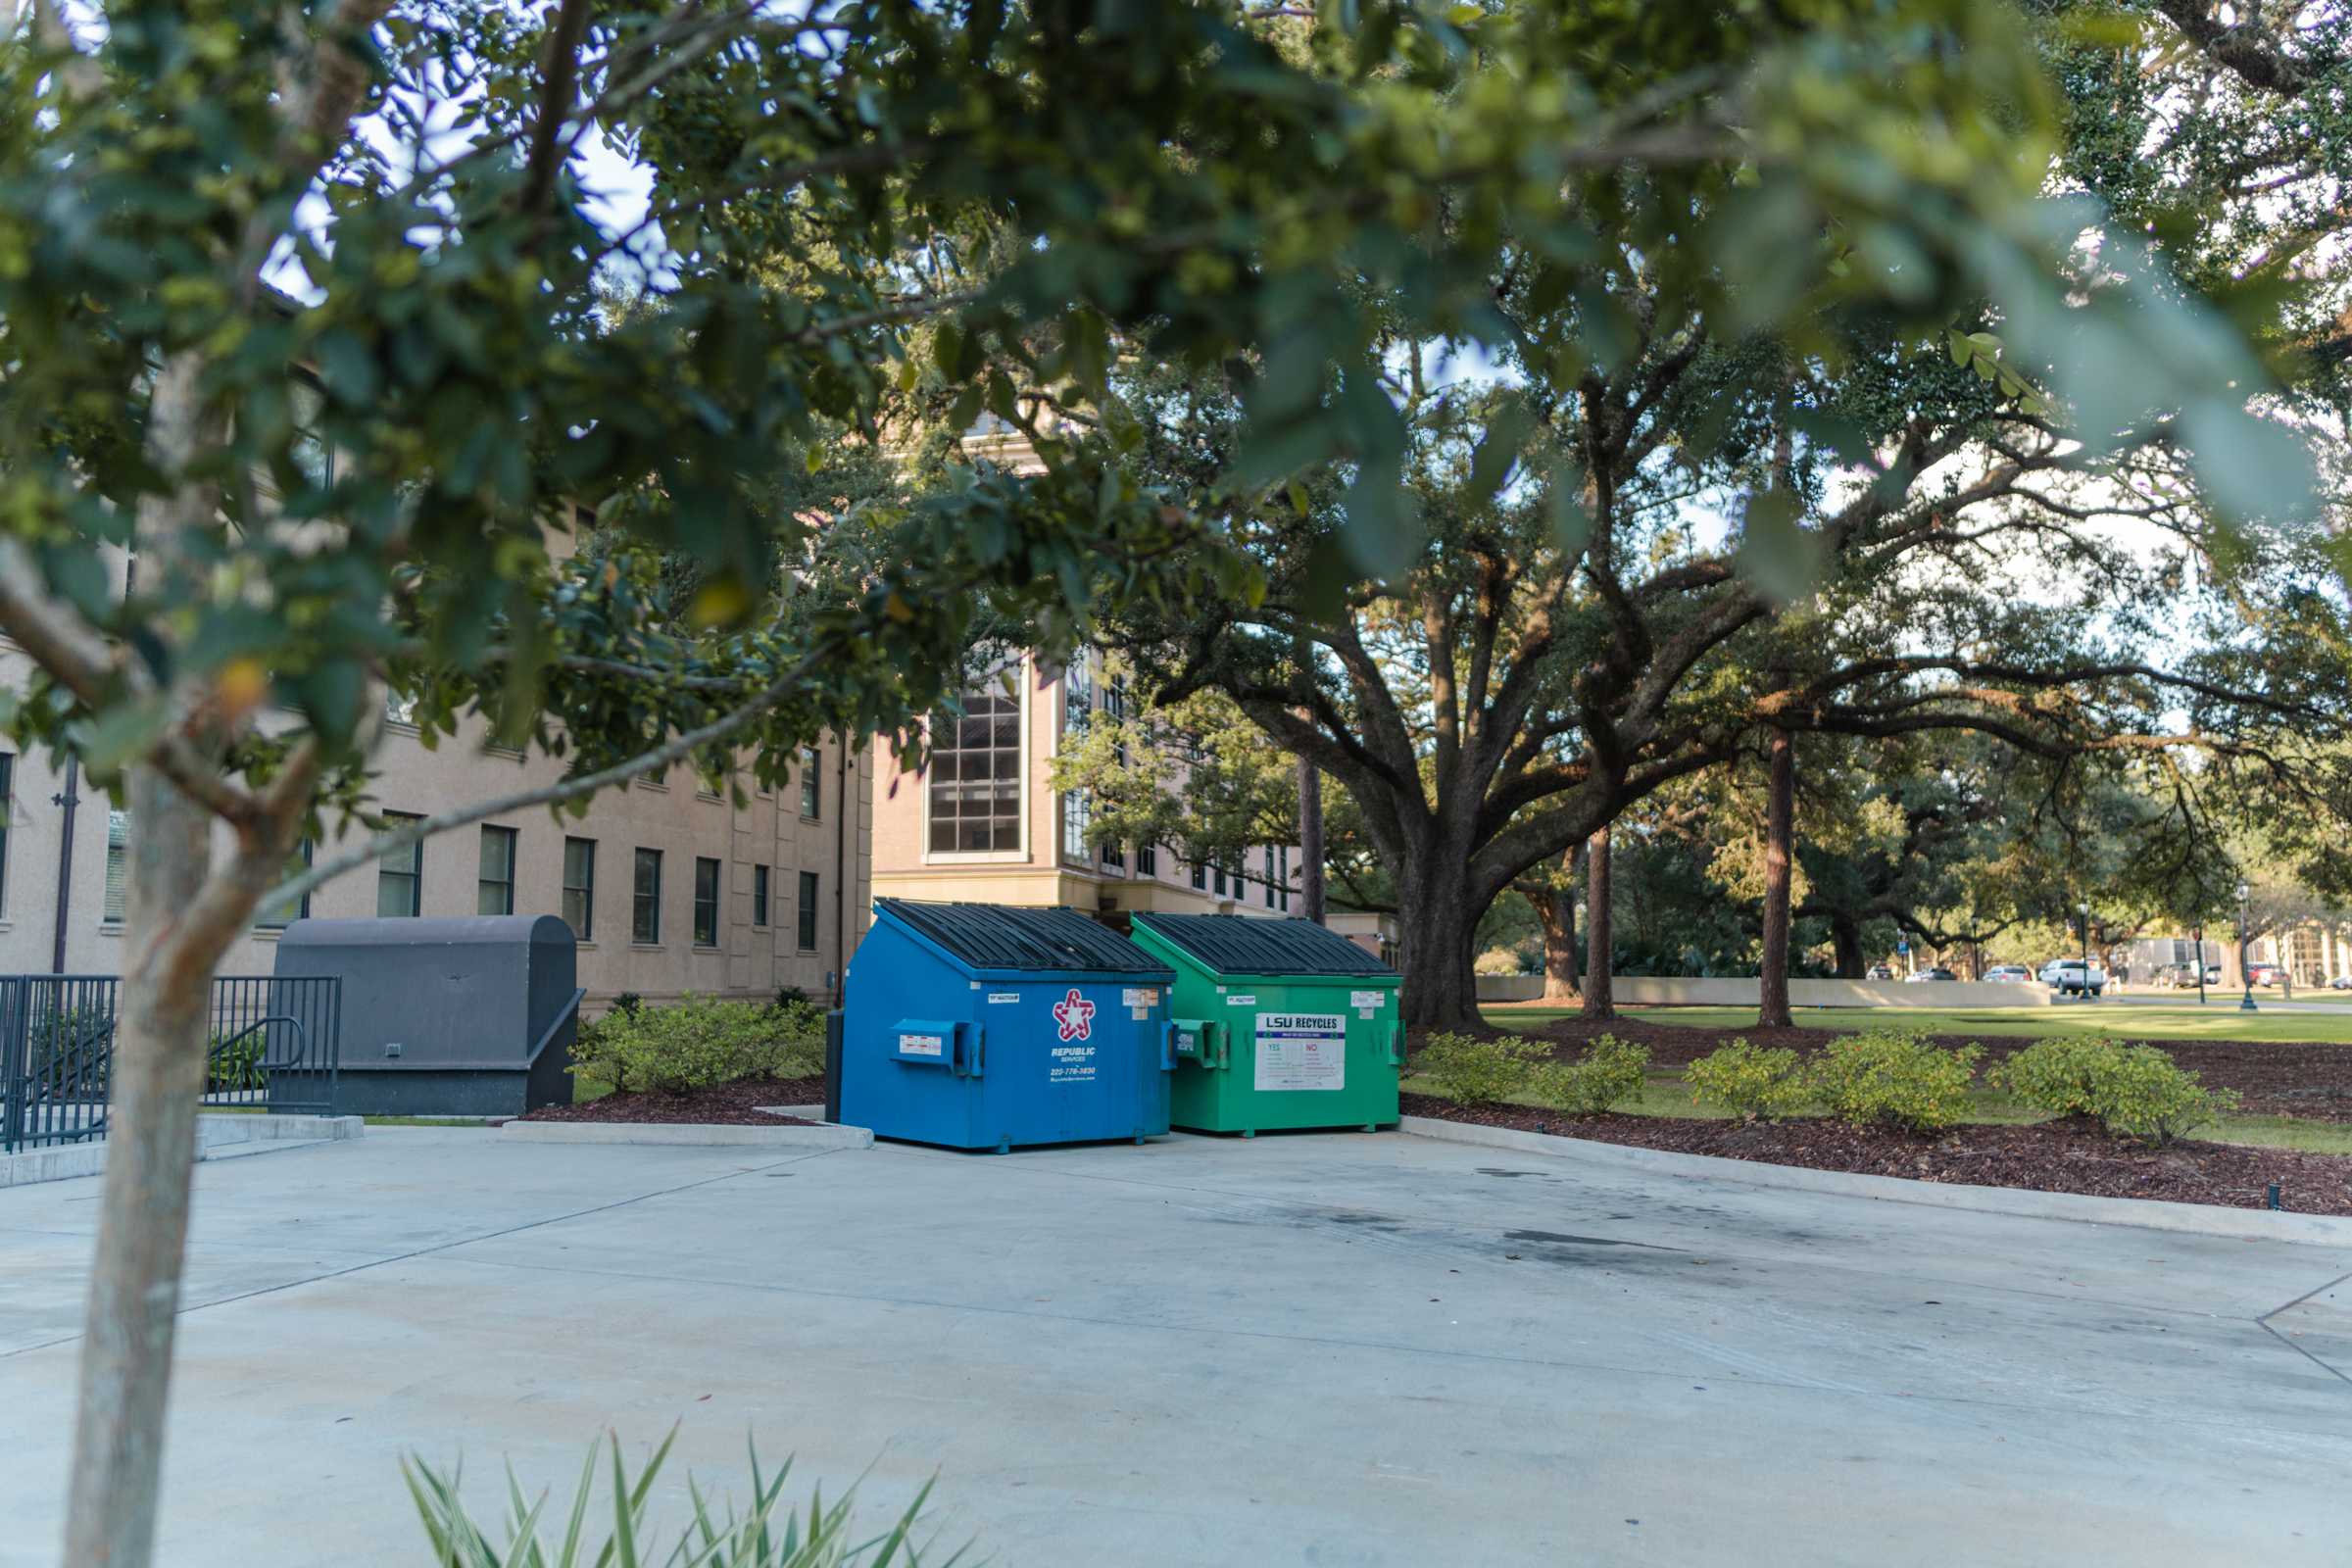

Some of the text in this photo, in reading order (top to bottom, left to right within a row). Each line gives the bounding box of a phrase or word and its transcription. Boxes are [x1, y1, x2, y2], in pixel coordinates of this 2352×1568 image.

[1266, 1017, 1337, 1029] LSU RECYCLES
[1051, 1047, 1096, 1056] REPUBLIC
[1305, 1043, 1318, 1052] NO
